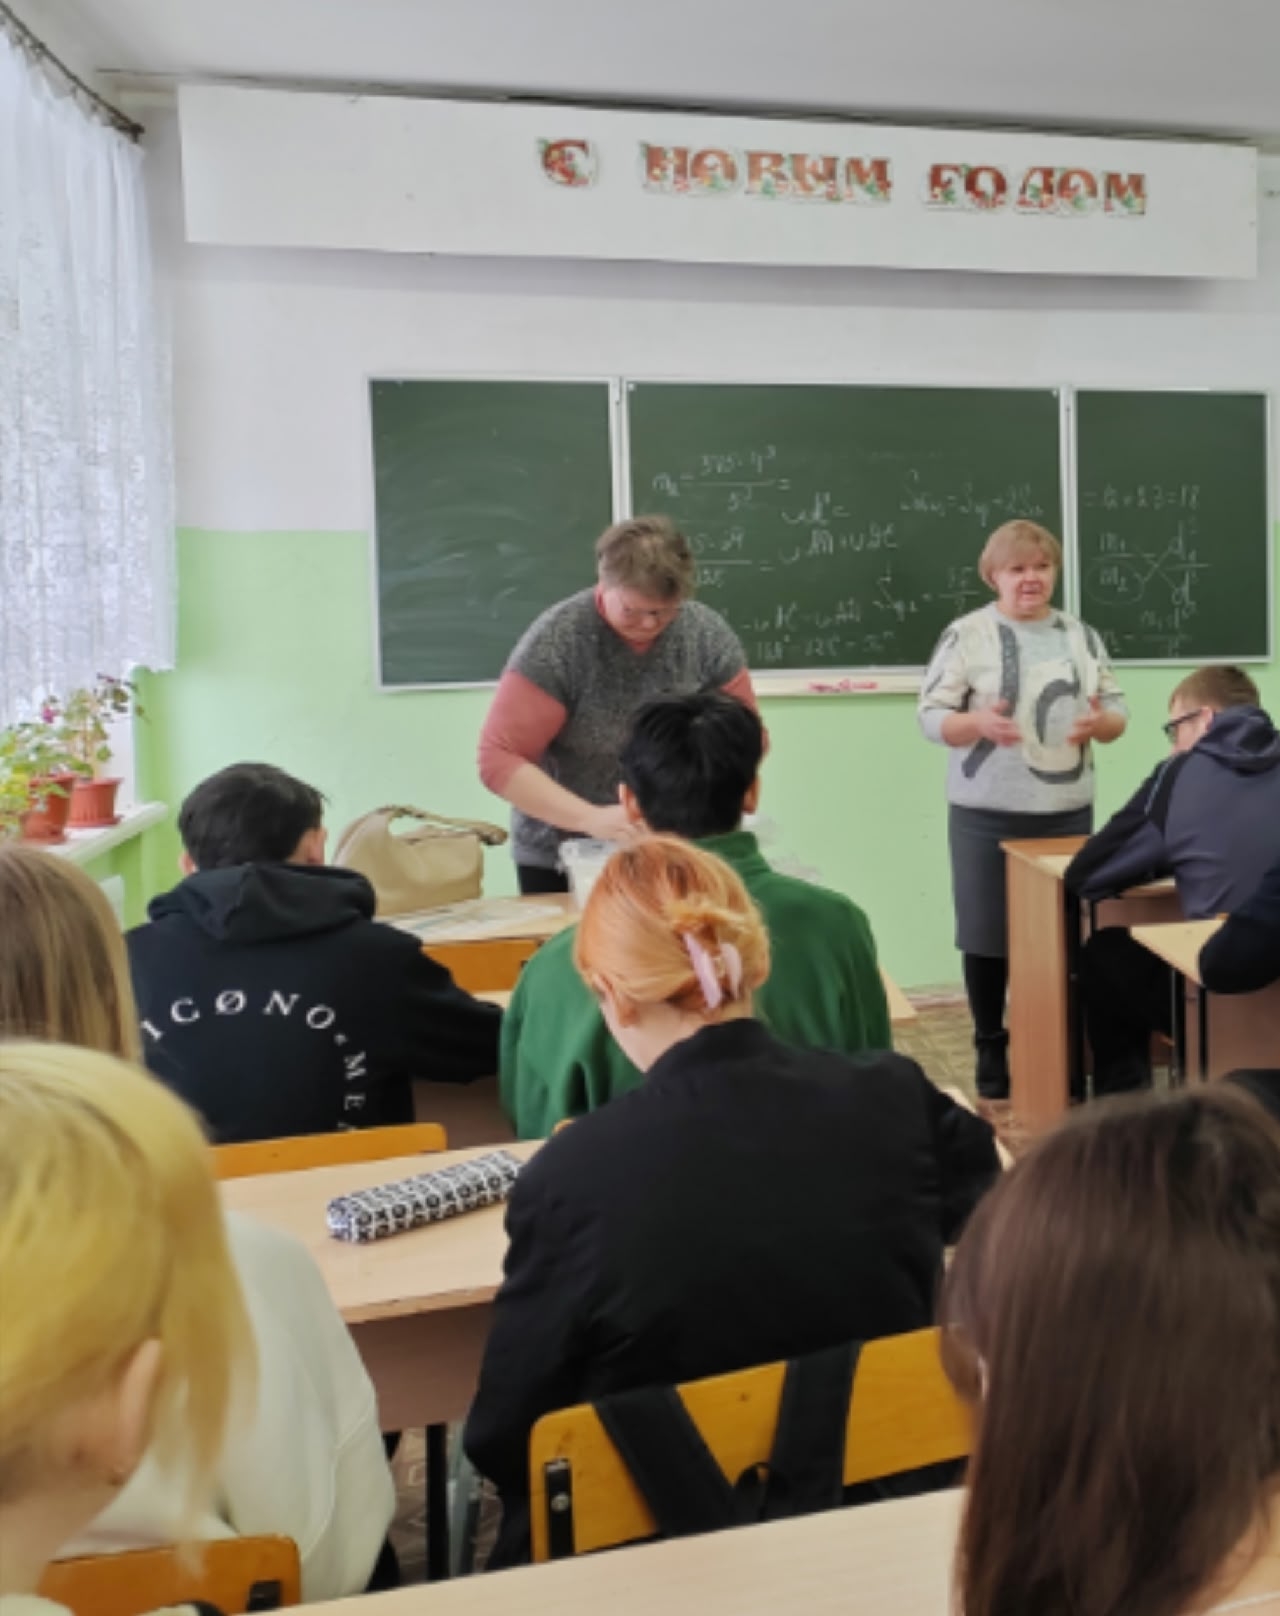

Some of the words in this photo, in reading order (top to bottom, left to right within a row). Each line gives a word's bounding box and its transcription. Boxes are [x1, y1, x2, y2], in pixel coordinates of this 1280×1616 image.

[537, 137, 594, 187] С
[639, 141, 892, 201] НОВЫМ
[926, 162, 1147, 216] ГОДОМ
